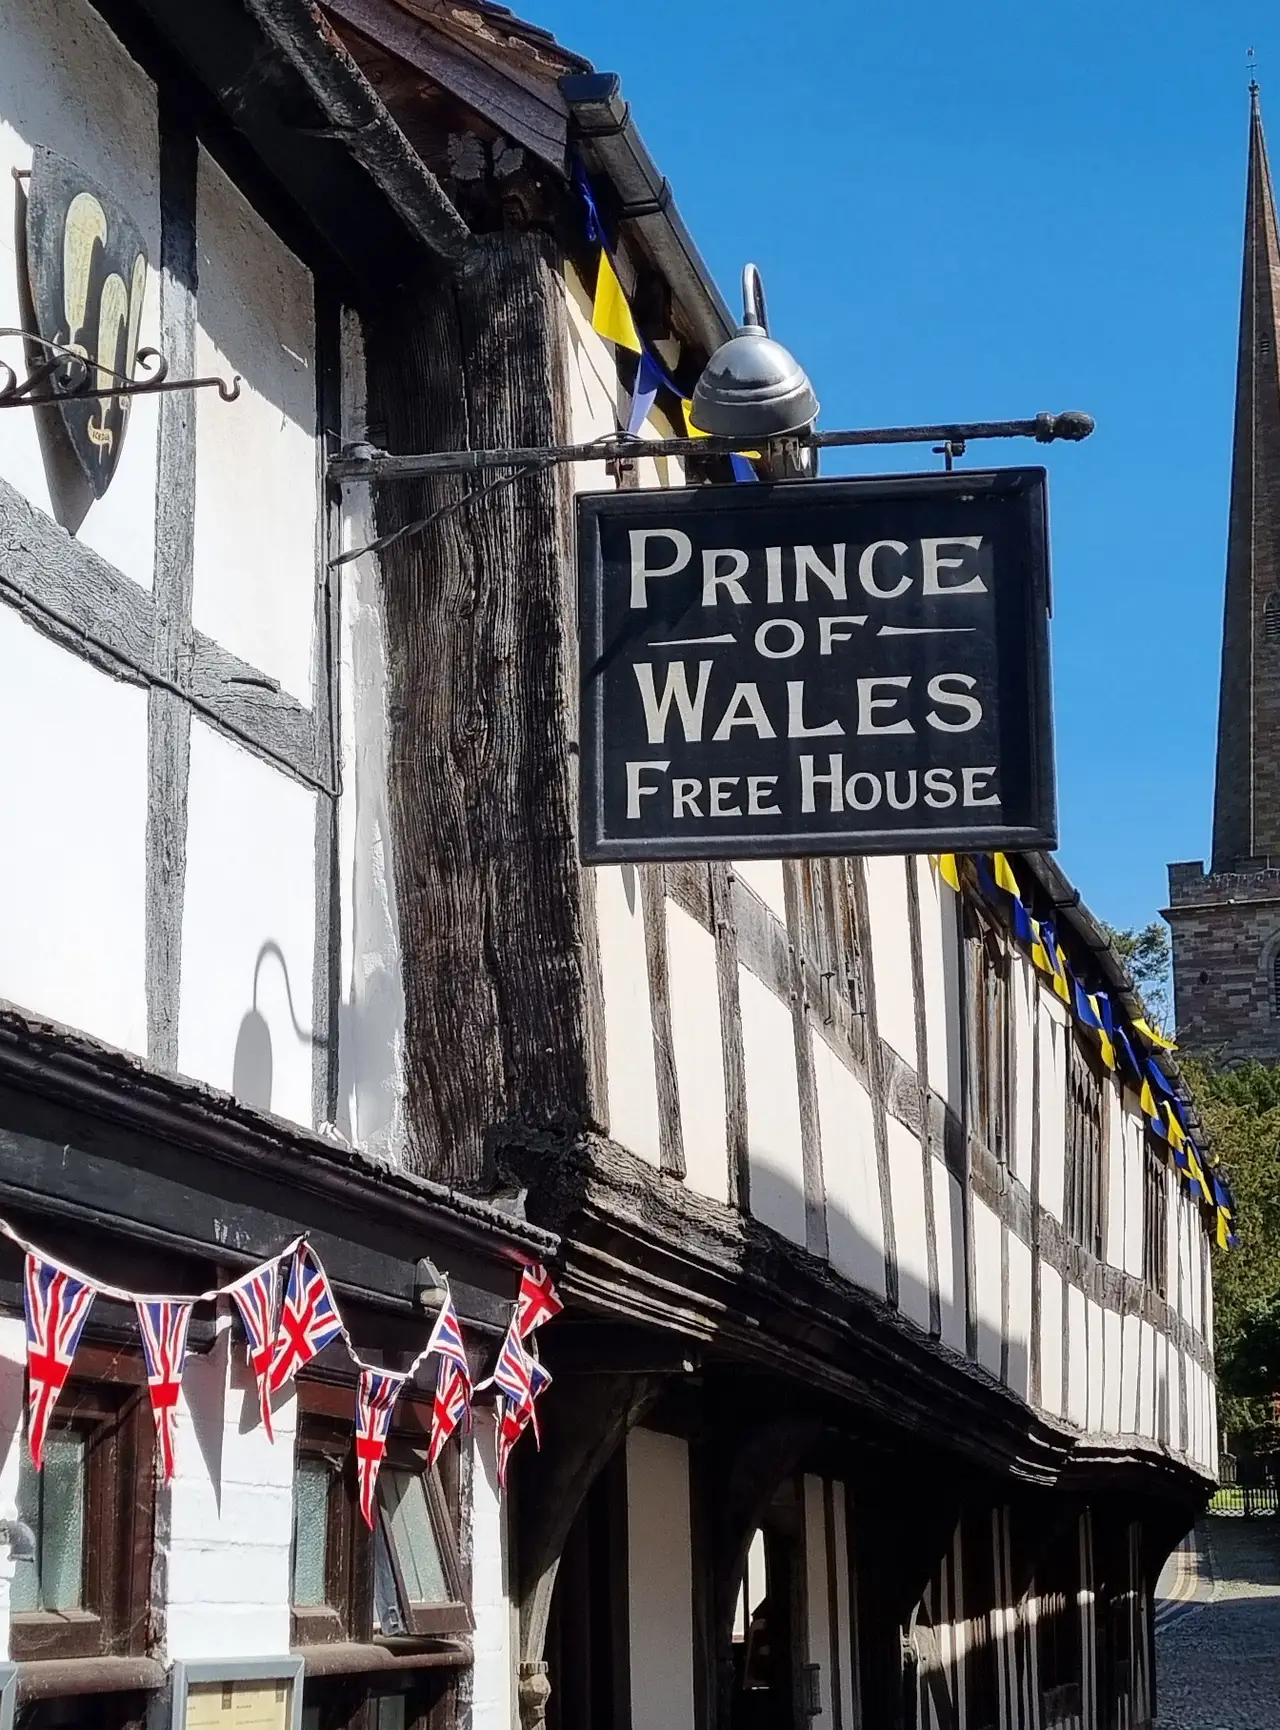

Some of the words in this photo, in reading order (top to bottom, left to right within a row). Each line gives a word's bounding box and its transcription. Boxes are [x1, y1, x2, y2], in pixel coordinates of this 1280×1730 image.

[628, 528, 988, 609] PRINCE
[754, 614, 869, 659] OF
[632, 659, 983, 744] WALES
[625, 760, 783, 819] FREE
[799, 753, 1001, 813] HOUSE
